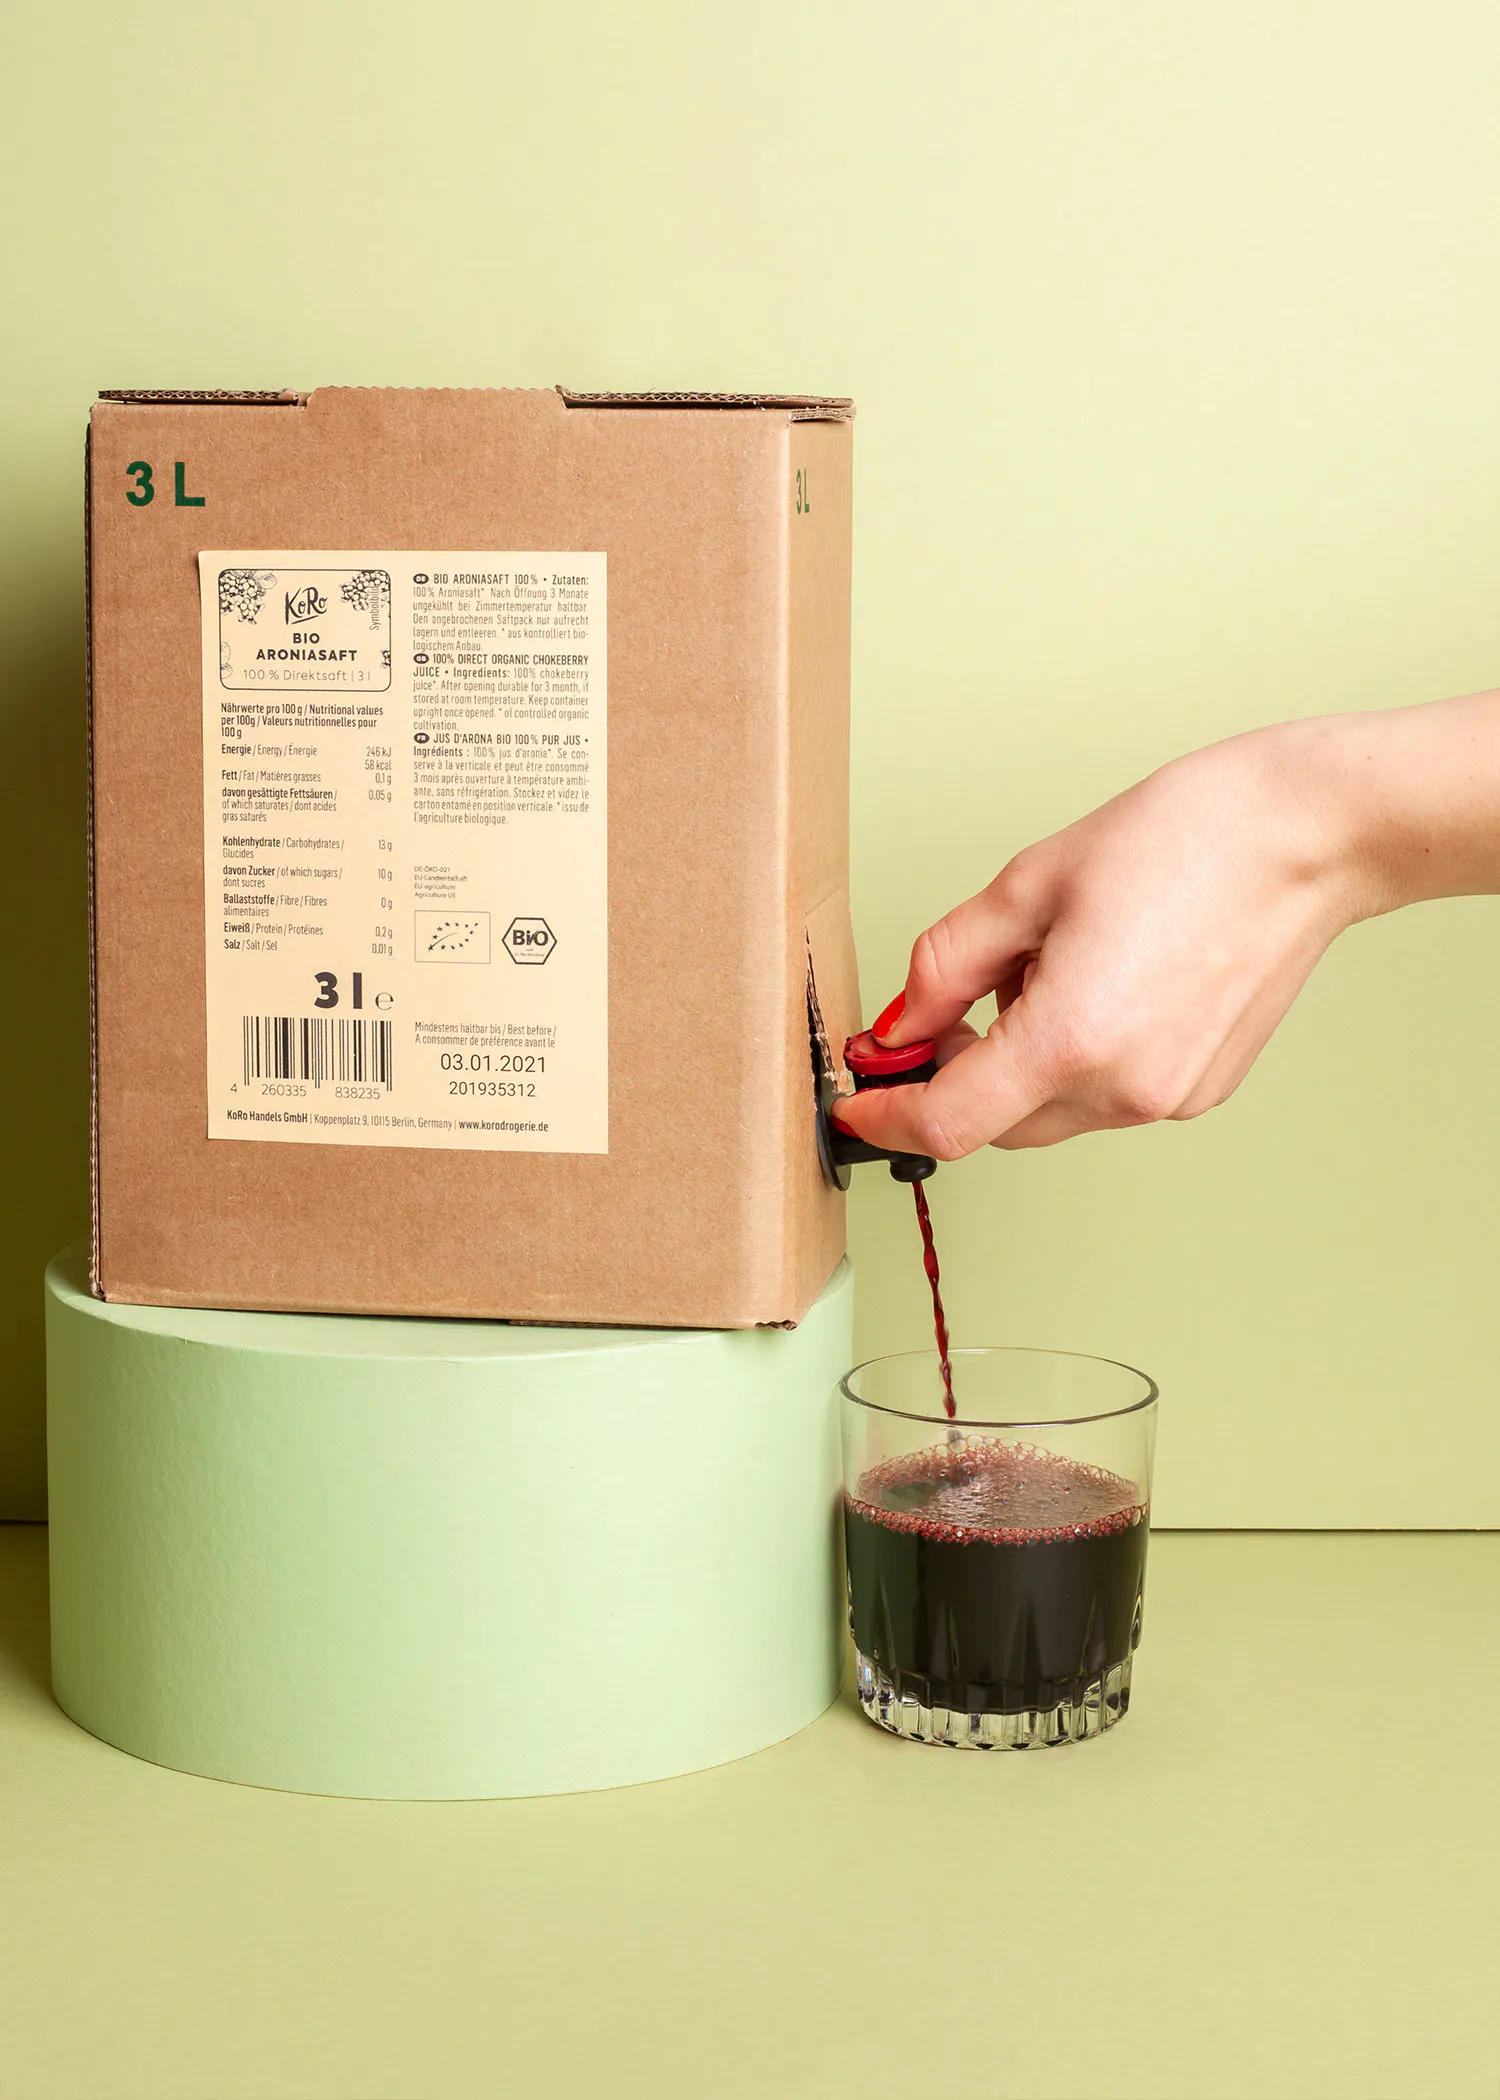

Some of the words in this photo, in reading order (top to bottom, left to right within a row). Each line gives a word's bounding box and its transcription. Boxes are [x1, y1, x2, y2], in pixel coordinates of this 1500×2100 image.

[126, 461, 154, 507] 3
[174, 462, 206, 507] L
[796, 468, 802, 515] 3
[804, 468, 810, 513] L
[434, 574, 448, 584] BIO
[453, 574, 509, 584] ARONIASAFT
[552, 574, 588, 585] Zutaten:
[285, 587, 328, 625] KoRo
[293, 633, 320, 644] BIO
[413, 641, 454, 652] logischem
[456, 641, 483, 651] Anbau.
[256, 649, 357, 661] ARONIASAFT
[433, 654, 454, 664] 100%
[458, 654, 487, 664] DIRECT
[492, 654, 529, 664] ORGANIC
[533, 655, 588, 665] CHOKEBERRY
[244, 670, 264, 680] 100
[269, 670, 279, 680] %
[283, 670, 347, 681] Direktsaft
[358, 671, 364, 681] 3
[413, 667, 440, 677] JUICE
[453, 667, 510, 678] Ingredients:
[514, 668, 536, 678] 100%
[540, 668, 589, 680] chokeberry
[441, 680, 461, 691] After
[464, 683, 495, 693] opening
[498, 681, 528, 692] durable
[531, 681, 542, 691] for
[545, 682, 549, 692] 3
[552, 682, 580, 693] month,
[583, 682, 588, 692] if
[221, 703, 264, 713] Nährwerte
[266, 706, 280, 716] pro
[282, 704, 296, 714] 100
[298, 707, 302, 716] g
[310, 704, 354, 715] Nutritional
[357, 706, 383, 715] values
[221, 717, 234, 727] per
[237, 716, 255, 727] 100g
[262, 716, 293, 726] Valeurs
[295, 717, 356, 728] nutritionnelles
[358, 718, 377, 729] pour
[413, 720, 459, 730] cultivation.
[222, 727, 235, 737] 100
[237, 729, 242, 739] g
[433, 734, 450, 743] JUS
[454, 734, 492, 744] D'ARONA
[497, 734, 511, 744] BIO
[542, 735, 559, 745] PUR
[563, 735, 581, 745] JUS
[222, 744, 251, 756] Energie
[258, 745, 282, 757] Energy
[289, 743, 317, 757] Énergie
[367, 747, 380, 756] 246
[382, 747, 391, 757] kJ
[414, 747, 462, 758] Ingrédients
[365, 760, 374, 770] 58
[376, 760, 391, 770] kcal
[222, 770, 237, 780] Fett
[243, 771, 255, 781] Fat
[261, 771, 292, 782] Matières
[293, 773, 321, 783] grasses
[387, 775, 391, 785] g
[222, 787, 246, 797] davon
[248, 788, 288, 800] gesättigte
[290, 788, 333, 799] Fettsäuren
[387, 792, 392, 802] g
[414, 787, 434, 798] ante,
[436, 788, 454, 797] sans
[457, 787, 511, 799] réfrigération.
[513, 788, 545, 798] Stockez
[548, 789, 555, 798] et
[558, 789, 578, 799] videz
[582, 790, 589, 799] le
[222, 799, 229, 809] of
[231, 799, 253, 809] which
[255, 801, 289, 810] saturates
[294, 801, 311, 810] dont
[313, 802, 337, 811] acides
[222, 814, 238, 823] gras
[240, 812, 267, 822] saturés
[222, 836, 281, 848] Kohlenhydrate
[286, 838, 340, 849] Carbohydrates
[378, 839, 386, 849] 13
[387, 842, 392, 852] g
[222, 848, 254, 858] Glucides
[223, 865, 247, 875] davon
[248, 866, 275, 876] Zucker
[281, 867, 288, 877] of
[290, 867, 312, 877] which
[314, 869, 338, 879] sugars
[378, 869, 386, 879] 10
[387, 871, 392, 881] g
[223, 877, 240, 887] dont
[242, 879, 265, 888] sucres
[224, 894, 274, 904] Ballaststoffe
[280, 895, 300, 906] Fibre
[305, 896, 327, 906] Fibres
[381, 898, 386, 908] 0
[388, 900, 392, 910] g
[224, 907, 269, 917] alimentaires
[224, 922, 250, 933] Eiweiß
[256, 923, 282, 934] Protein
[288, 923, 323, 935] Protéines
[388, 929, 392, 939] g
[224, 939, 240, 949] Salz
[246, 940, 260, 950] Salt
[266, 940, 277, 950] Sel
[388, 946, 392, 956] g
[314, 972, 339, 1008] 3
[415, 1022, 458, 1033] Mindestens
[460, 1022, 488, 1034] haltbar
[490, 1024, 501, 1034] bis
[508, 1024, 525, 1035] Best
[527, 1025, 552, 1036] before
[415, 1034, 421, 1044] A
[422, 1035, 468, 1045] consommer
[469, 1036, 479, 1045] de
[481, 1036, 522, 1047] préférence
[524, 1038, 546, 1048] avant
[548, 1038, 555, 1048] le
[440, 1053, 545, 1073] 03.01.2021
[231, 1083, 237, 1093] 4
[262, 1084, 307, 1096] 260335
[335, 1087, 380, 1099] 838235
[449, 1081, 536, 1097] 201935312
[227, 1110, 248, 1121] KoRo
[250, 1111, 282, 1122] Handels
[284, 1112, 308, 1122] GmbH
[314, 1114, 360, 1126] Koppenplatz
[362, 1115, 369, 1126] 9,
[371, 1116, 389, 1126] 10115
[392, 1117, 416, 1128] Berlin,
[418, 1117, 451, 1130] Germany
[459, 1120, 549, 1133] www.korodrogerie.de
